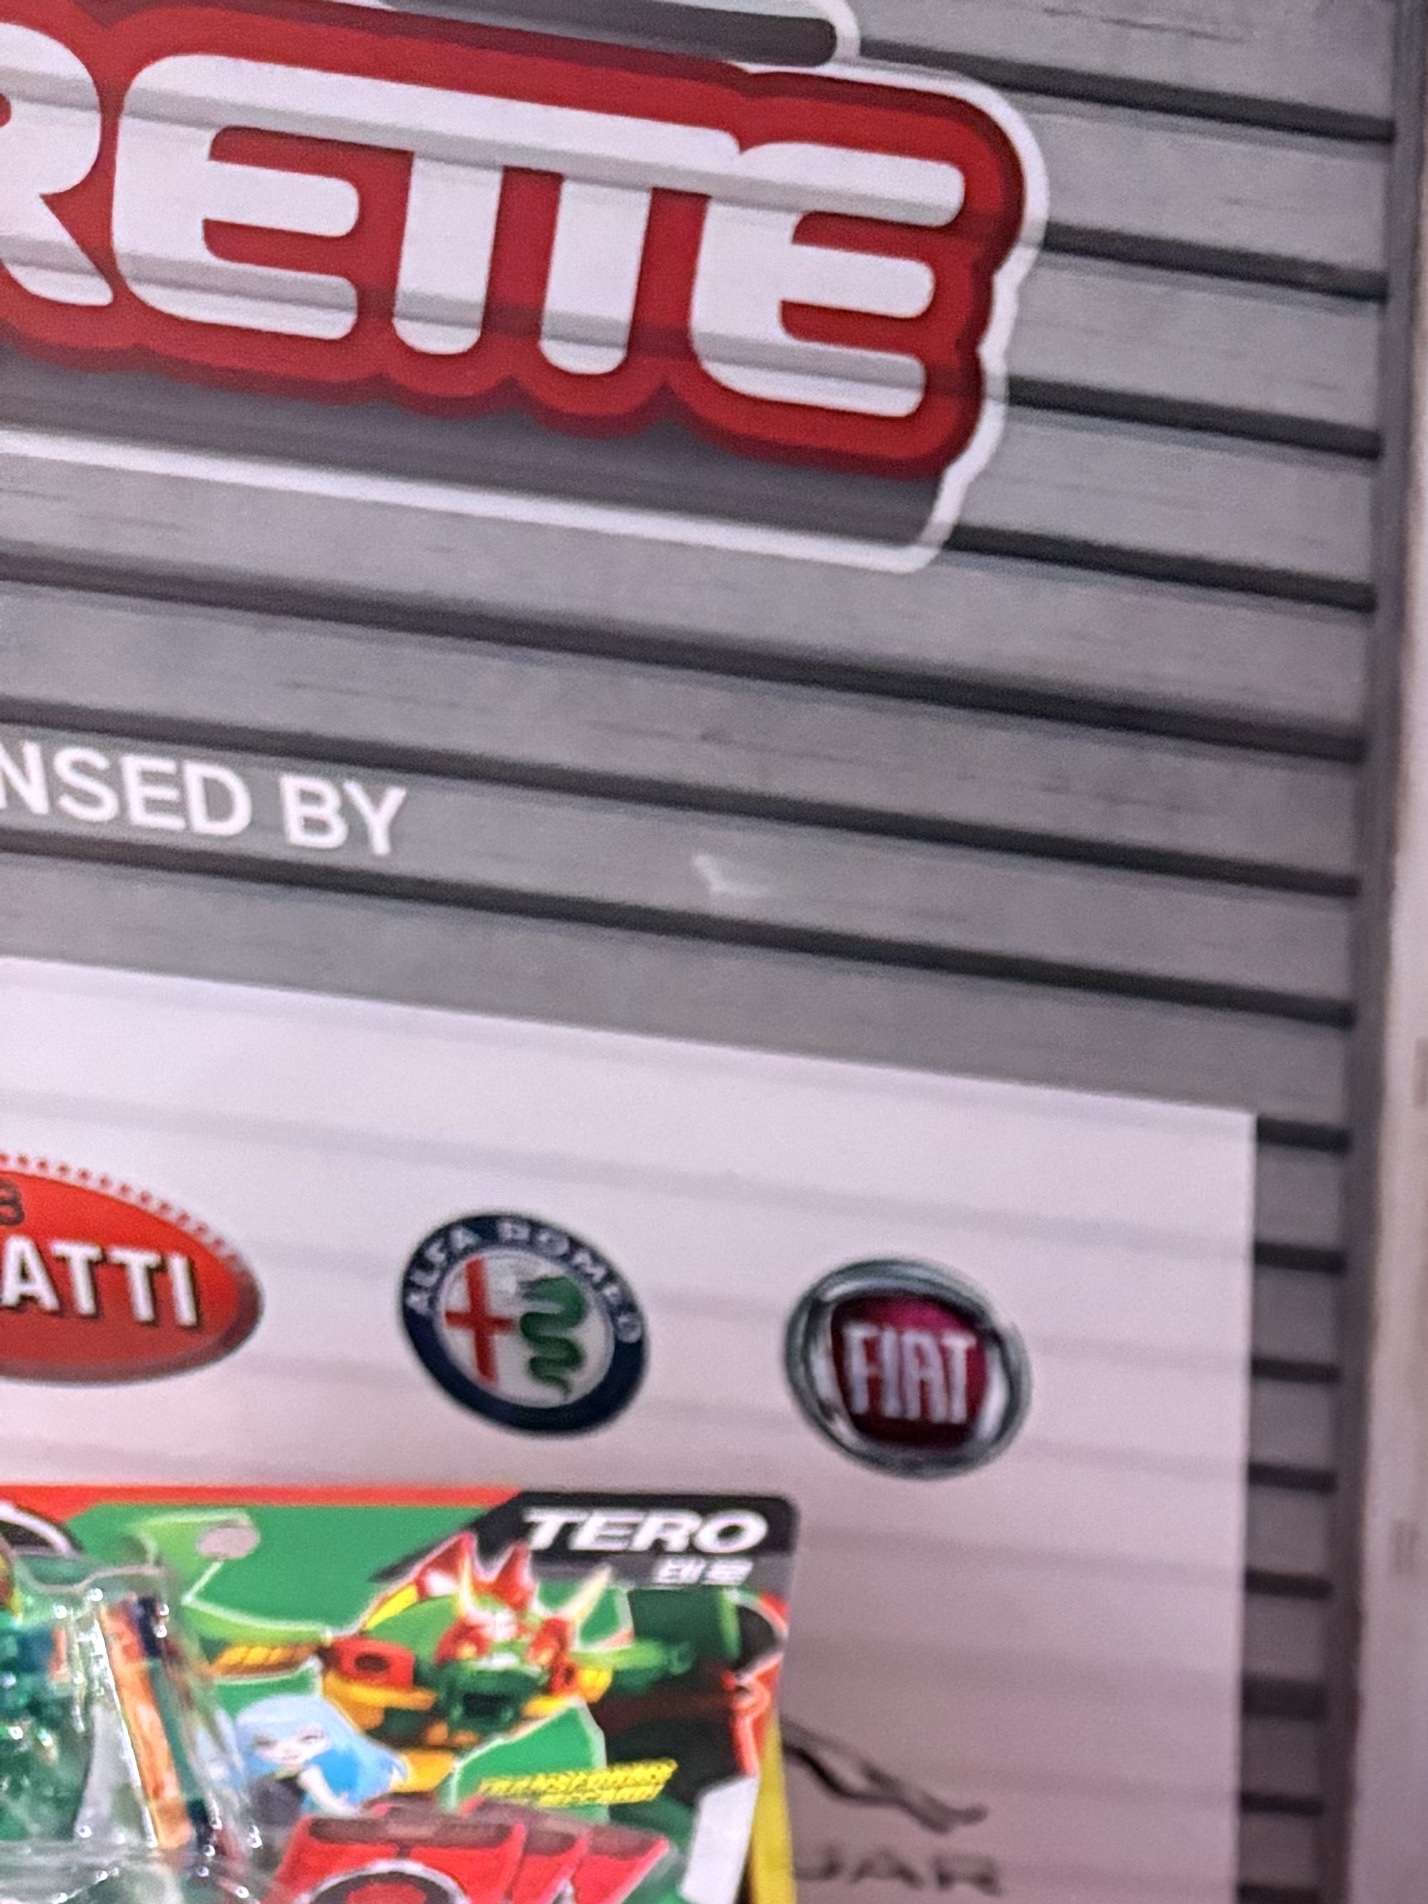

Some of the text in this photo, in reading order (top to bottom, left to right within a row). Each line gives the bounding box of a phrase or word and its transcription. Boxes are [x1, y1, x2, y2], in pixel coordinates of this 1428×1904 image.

[0, 22, 967, 418] RETTE
[0, 740, 408, 857] NSED BY
[0, 1234, 199, 1328] ATTI
[845, 1323, 980, 1426] FIAT
[524, 1508, 768, 1556] TERO
